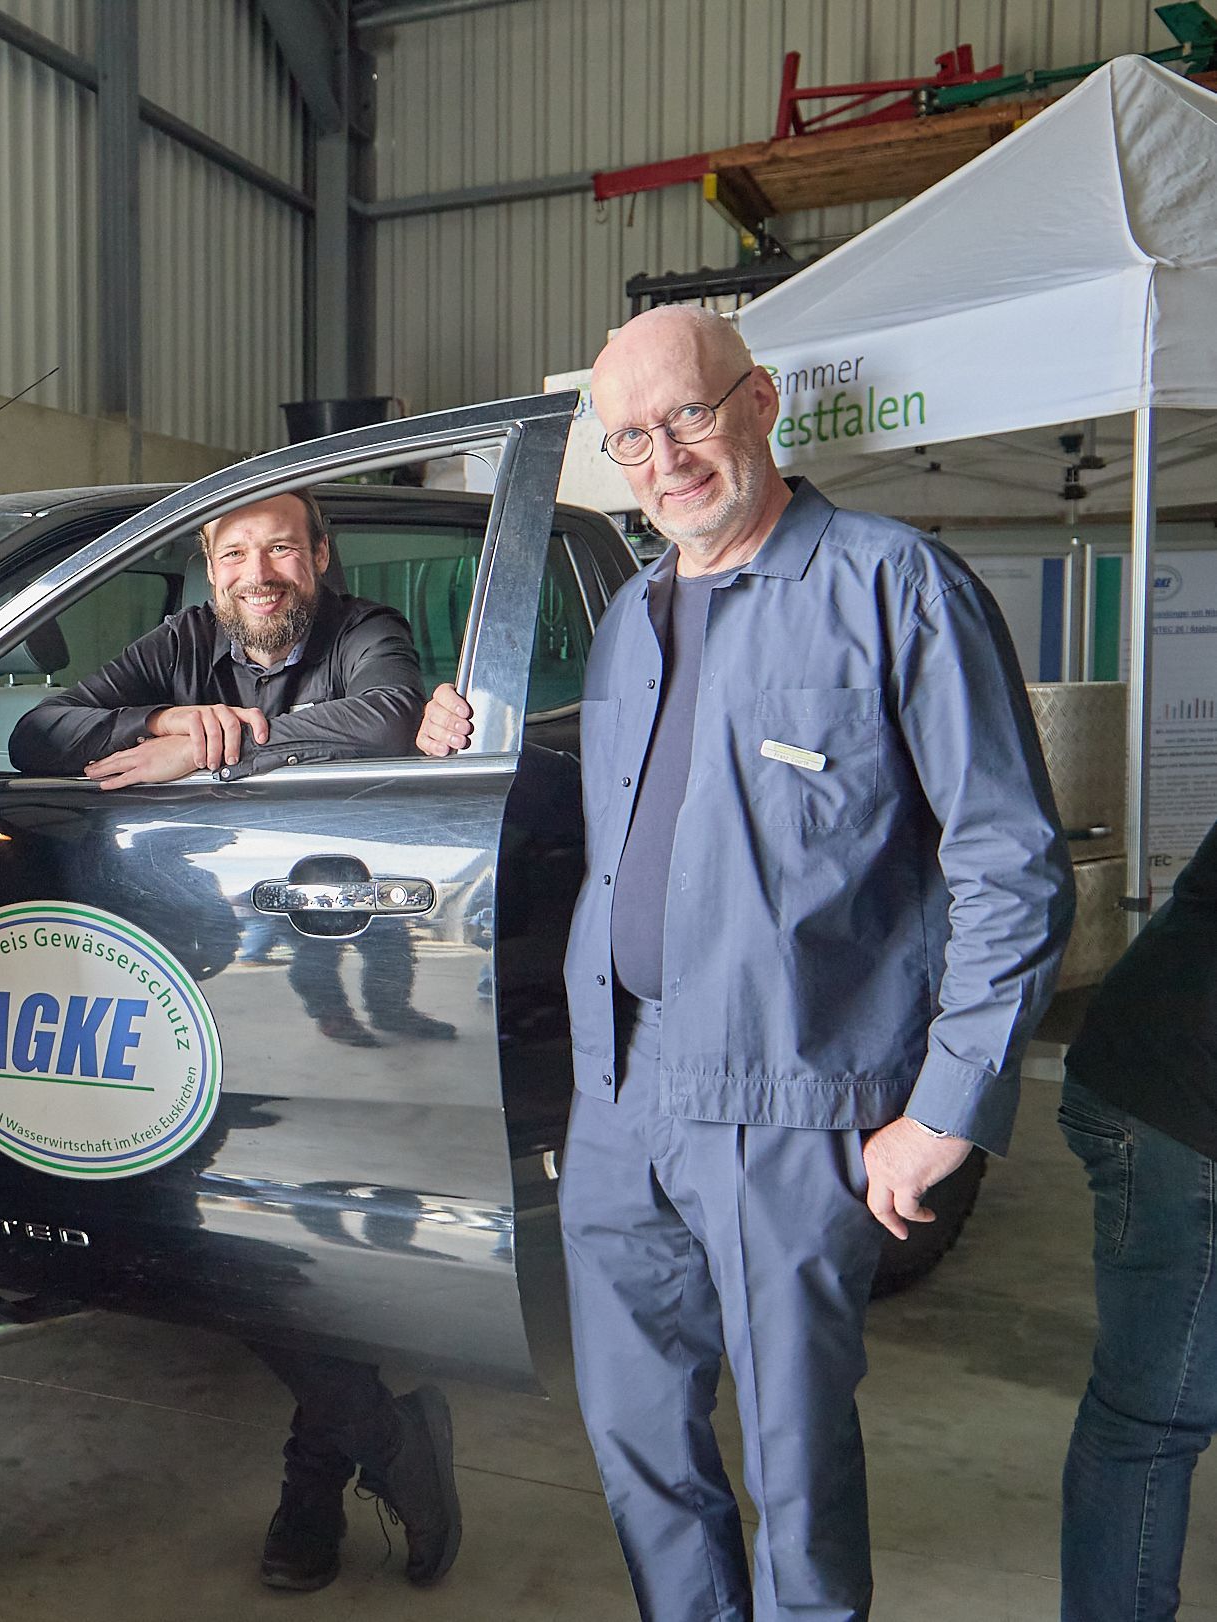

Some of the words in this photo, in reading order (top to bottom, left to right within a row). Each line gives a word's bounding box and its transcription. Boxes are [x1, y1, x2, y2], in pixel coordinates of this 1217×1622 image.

[771, 356, 865, 396] ammer
[768, 386, 925, 448] estfalen
[1146, 854, 1172, 867] TEC
[33, 927, 191, 1051] Gewässerschutz
[5, 1116, 113, 1153] Wasserwirtschaft
[114, 1137, 132, 1150] im
[130, 1124, 162, 1146] Kreis
[158, 1065, 197, 1129] Euskirchen
